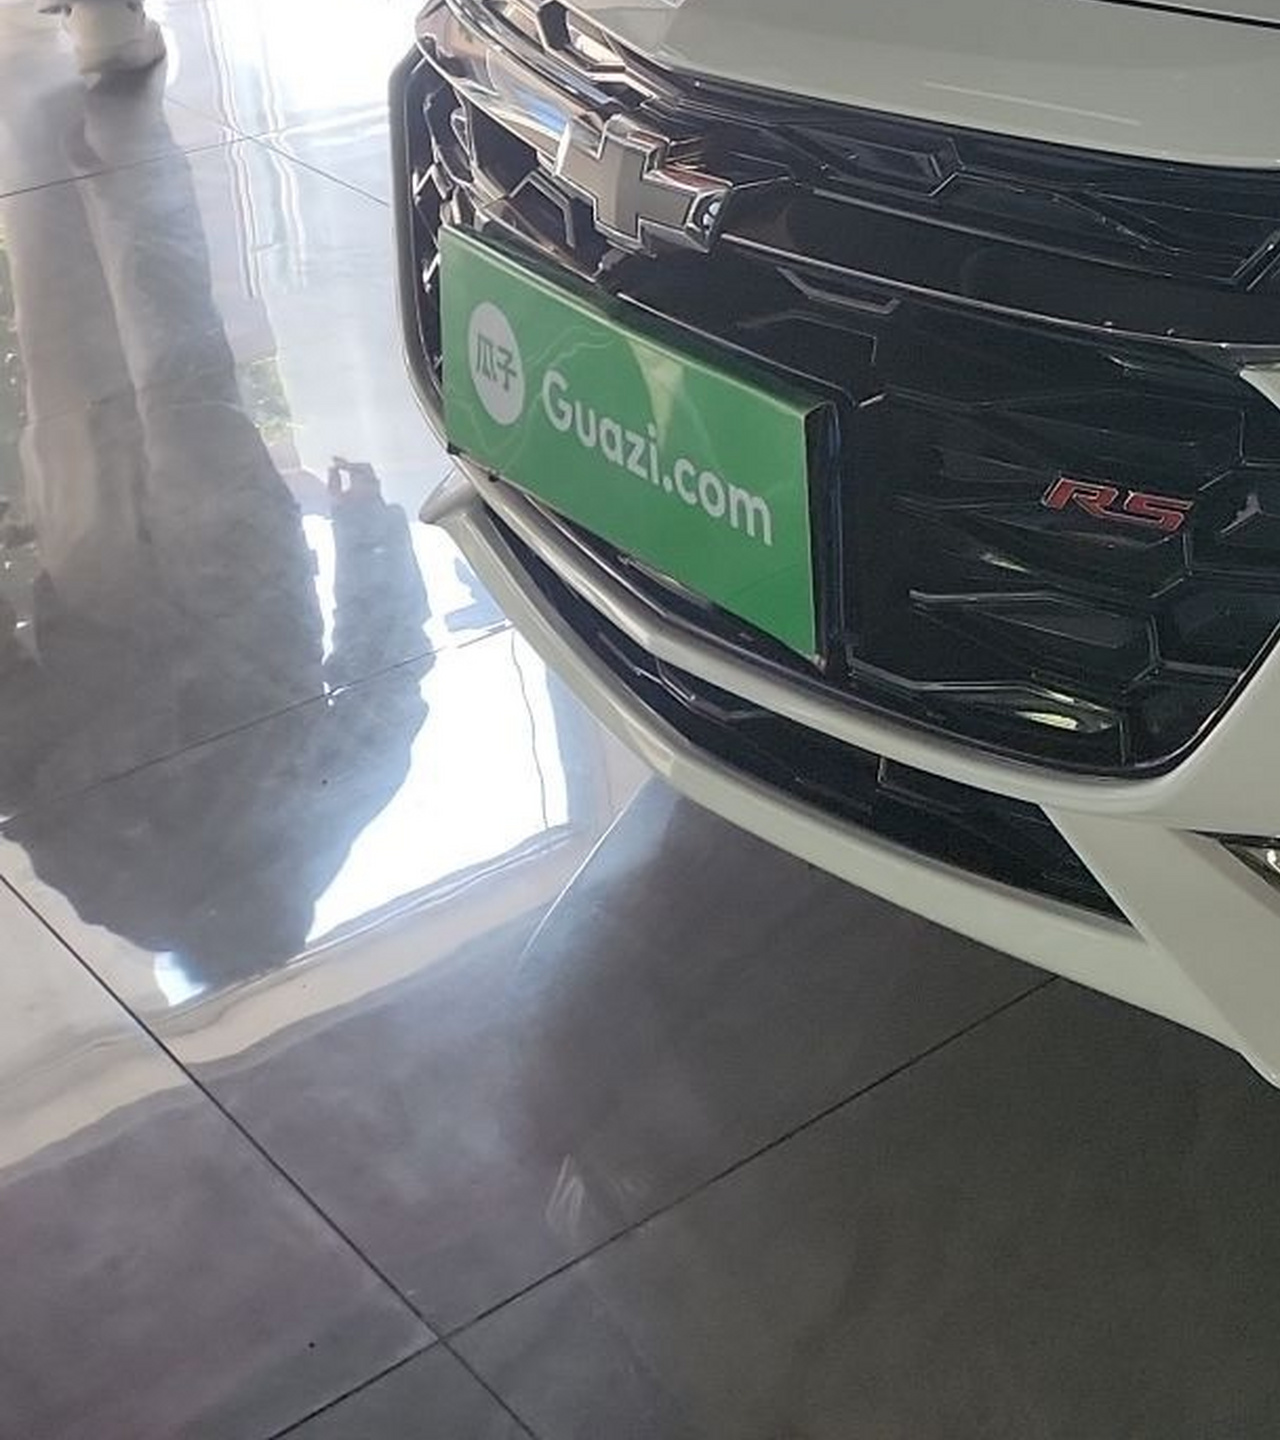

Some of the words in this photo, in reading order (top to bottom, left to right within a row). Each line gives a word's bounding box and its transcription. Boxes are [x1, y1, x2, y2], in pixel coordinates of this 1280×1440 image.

[476, 332, 517, 392] 瓜子
[541, 370, 773, 547] Guazi.com
[1041, 476, 1194, 532] RS
